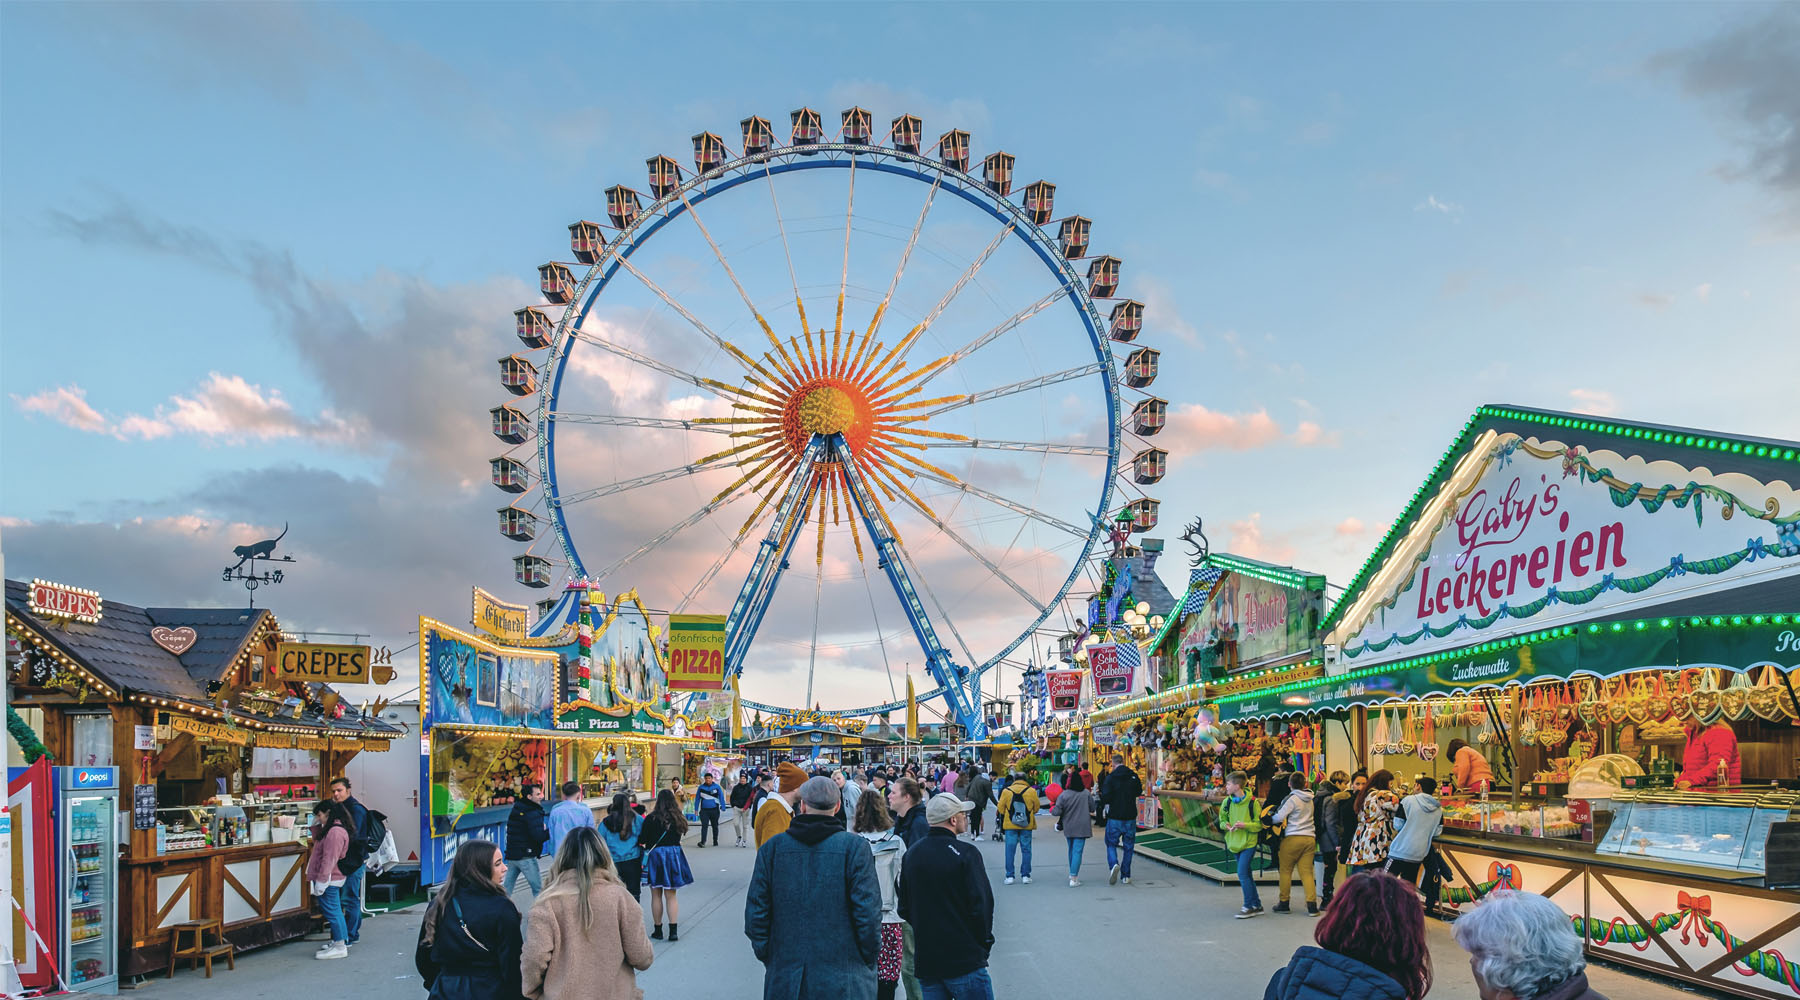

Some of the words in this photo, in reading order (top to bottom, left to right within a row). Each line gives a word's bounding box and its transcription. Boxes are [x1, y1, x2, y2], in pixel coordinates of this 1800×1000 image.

[1455, 474, 1560, 571] Gaby's
[1417, 511, 1627, 619] Leckereien
[34, 587, 96, 617] CRÊPES
[670, 633, 724, 643] ofenfrische
[282, 649, 364, 676] CRÊPES
[671, 649, 721, 674] PIZZA
[1097, 652, 1118, 665] Scho
[1452, 658, 1510, 680] Zuckerwatte
[588, 718, 619, 729] Pizza
[762, 708, 866, 733] Willenborg
[89, 773, 108, 782] pepsi
